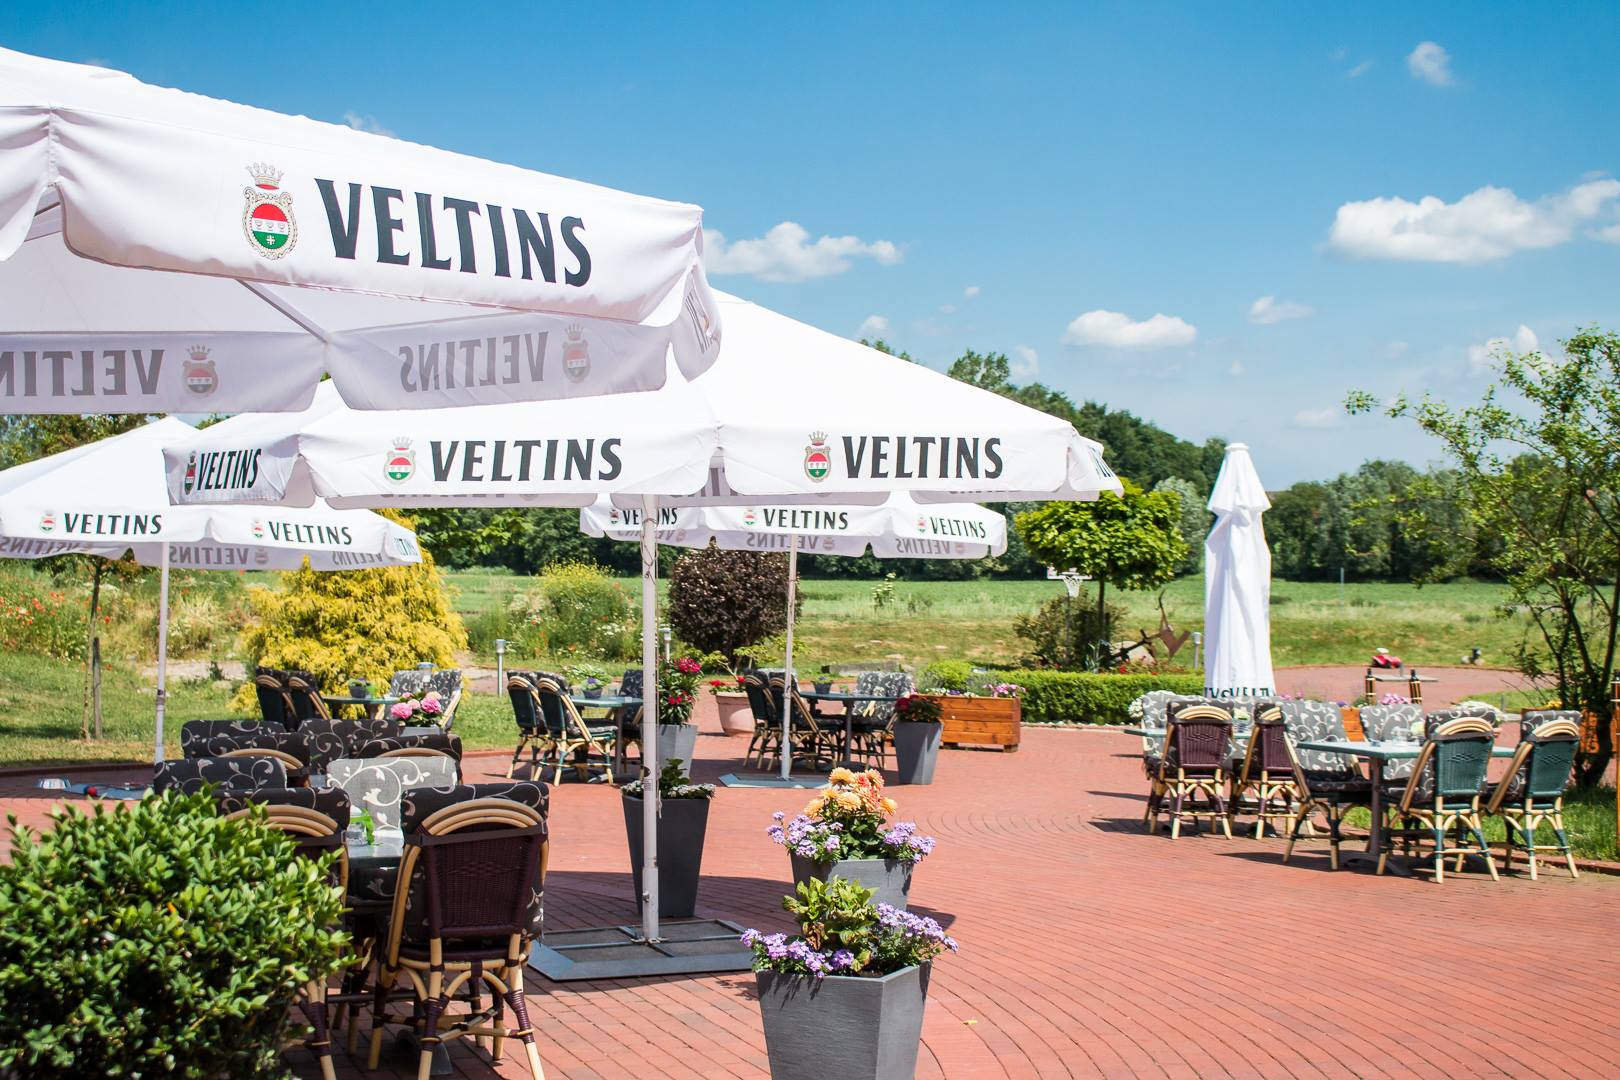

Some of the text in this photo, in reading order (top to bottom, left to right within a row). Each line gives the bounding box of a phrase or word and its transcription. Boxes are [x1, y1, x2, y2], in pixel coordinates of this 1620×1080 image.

[314, 178, 592, 288] VELTINS
[197, 448, 262, 490] VELTINS
[431, 438, 622, 481] VELTINS
[842, 436, 1003, 479] VELTINS
[64, 512, 162, 535] VELTINS
[622, 507, 678, 525] VEINS
[763, 508, 849, 530] VELTINS
[930, 516, 986, 538] VELTINS
[268, 520, 352, 545] VELTINS
